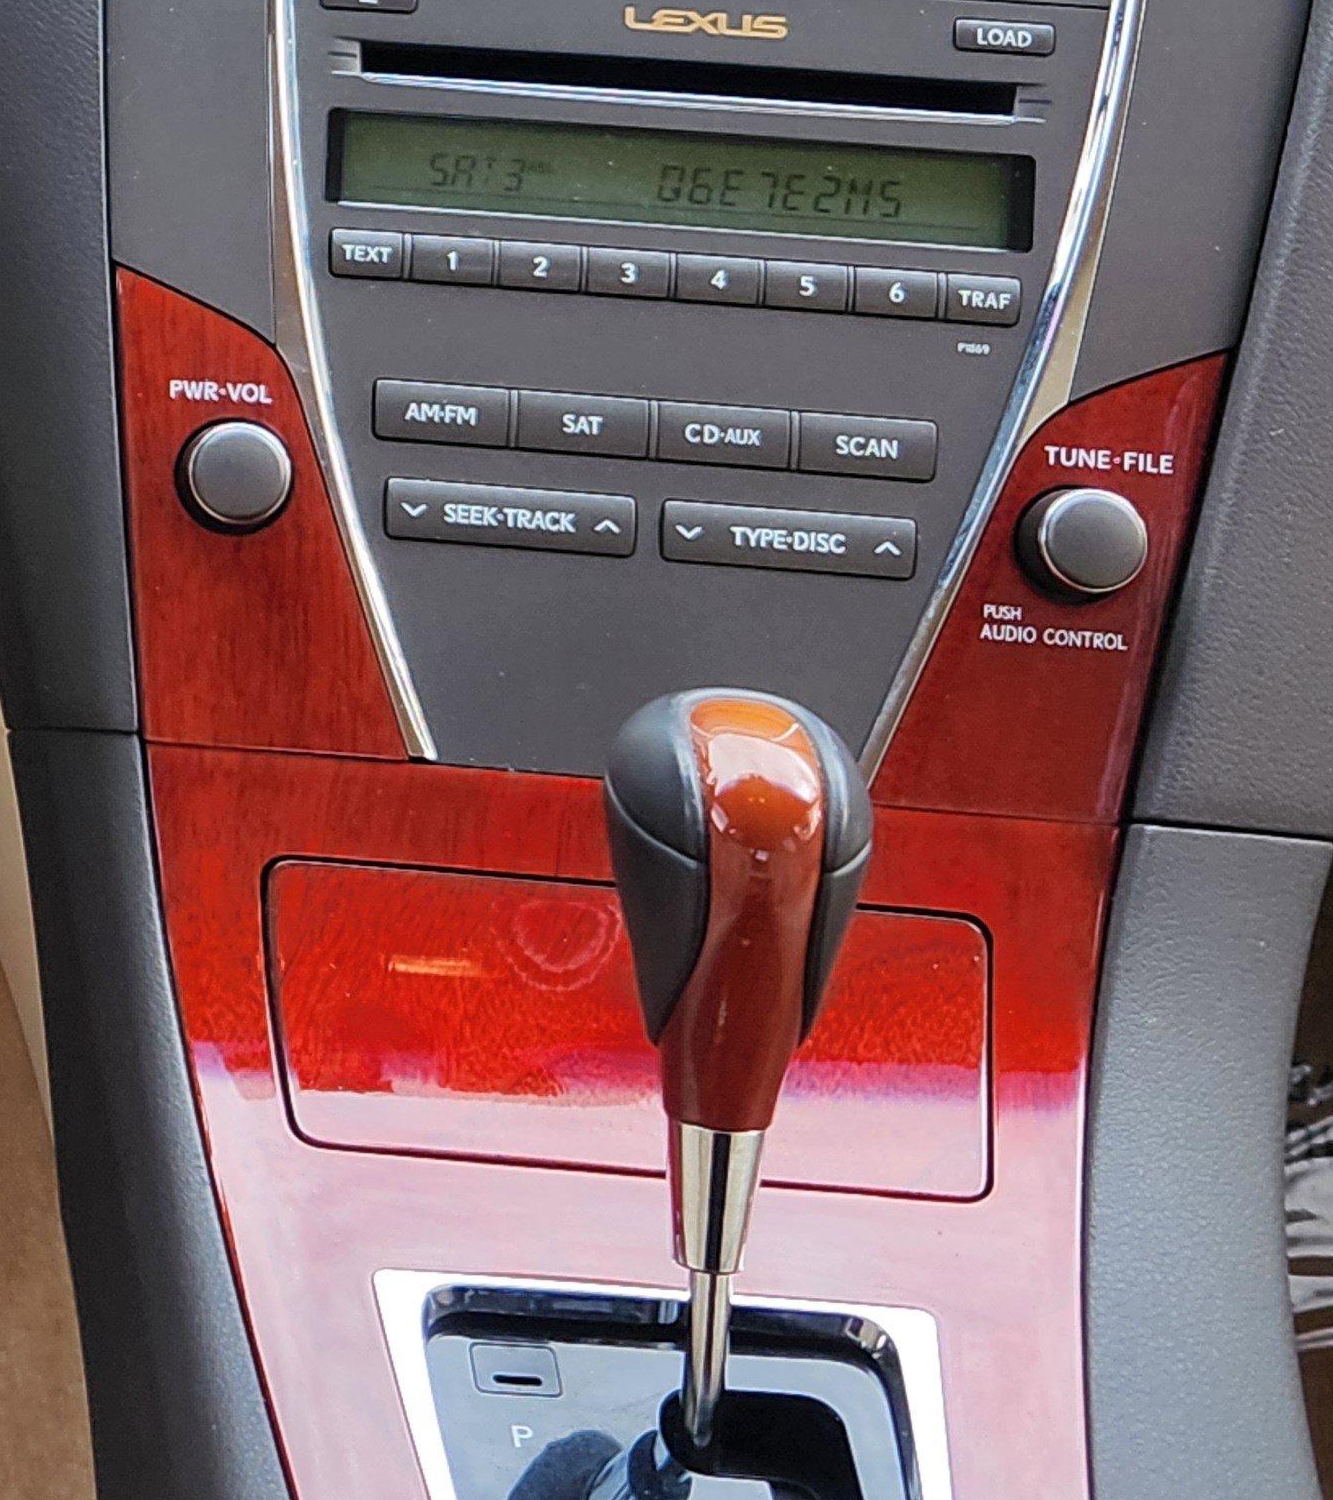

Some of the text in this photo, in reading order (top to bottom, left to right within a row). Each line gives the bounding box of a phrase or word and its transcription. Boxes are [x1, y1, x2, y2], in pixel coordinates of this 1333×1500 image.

[623, 5, 790, 41] LEXUS
[975, 27, 1034, 50] LOAD
[341, 244, 393, 264] TEXT
[446, 251, 460, 271] 1
[532, 257, 549, 278] 2
[619, 262, 638, 284] 3
[709, 269, 729, 290] 4
[799, 276, 815, 297] 5
[889, 282, 906, 303] 6
[957, 289, 1013, 311] TRAF
[562, 413, 603, 436] SAT
[835, 435, 899, 460] SCAN
[982, 603, 1022, 621] PUSH
[979, 623, 1129, 651] AUDIO CONTROL
